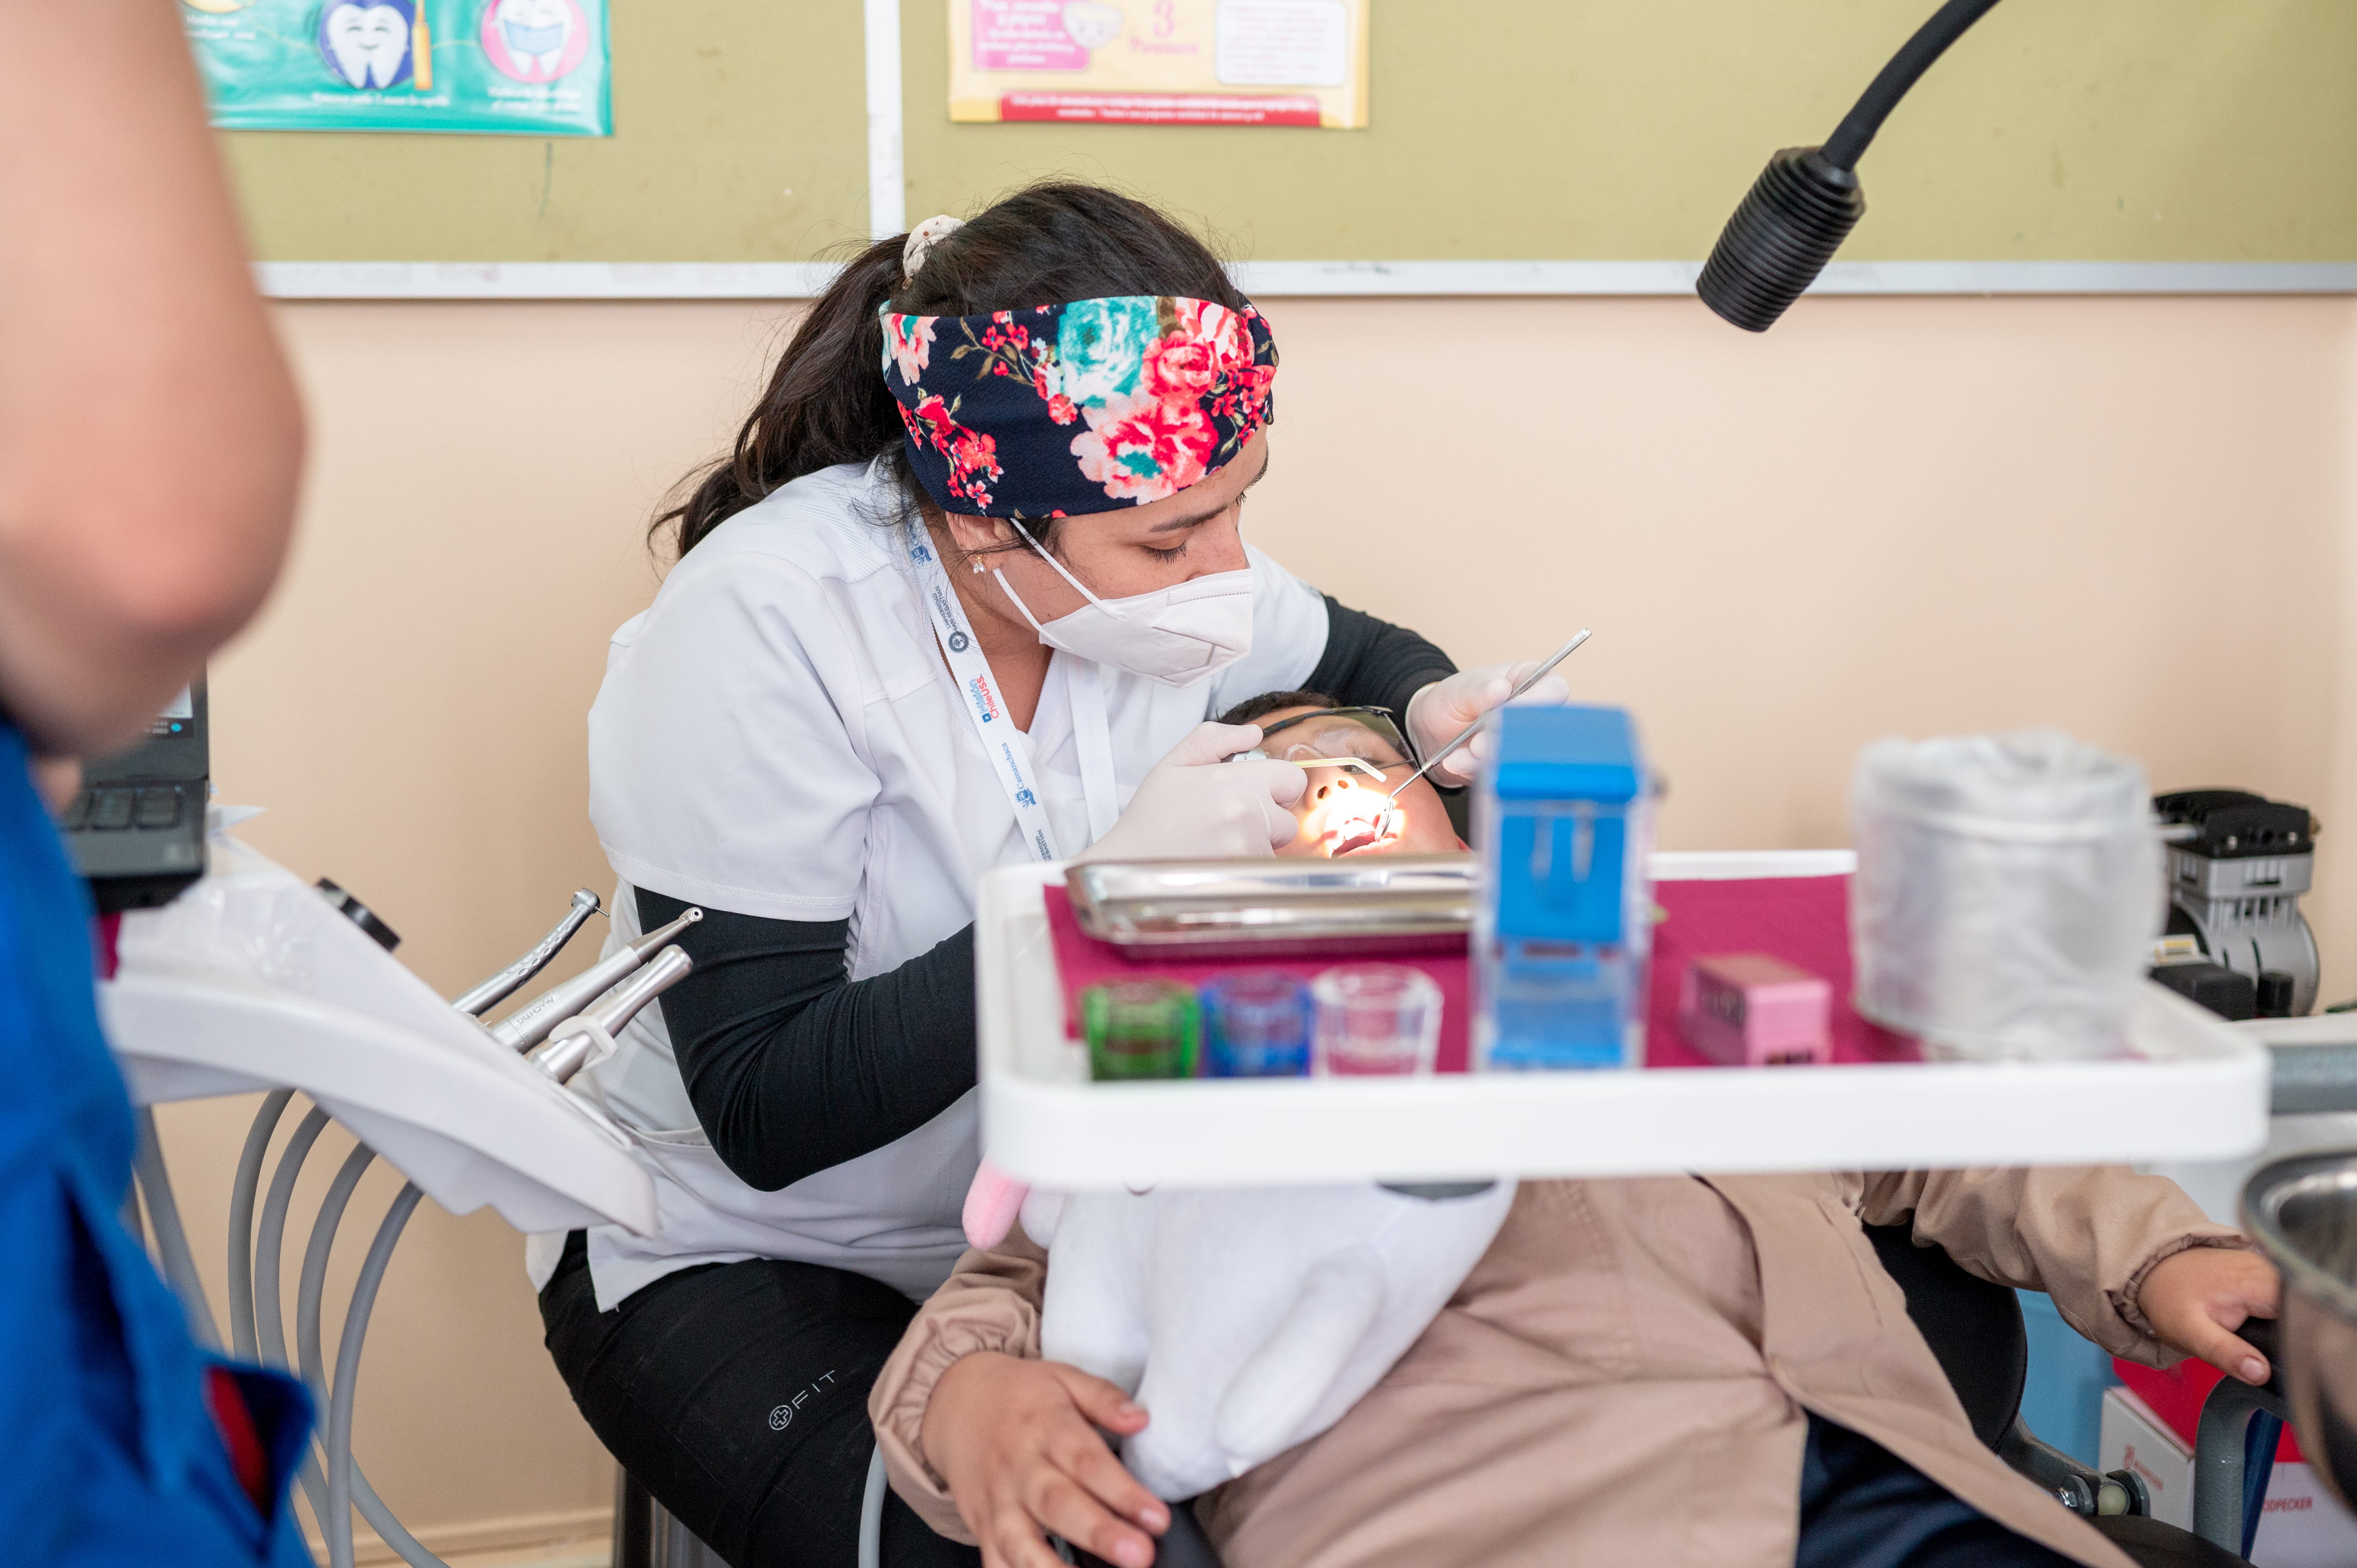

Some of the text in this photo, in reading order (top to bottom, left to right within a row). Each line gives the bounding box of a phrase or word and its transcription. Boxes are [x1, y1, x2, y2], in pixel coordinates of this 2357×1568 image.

[933, 593, 951, 629] UNIVERSIDAD
[935, 585, 953, 618] SEBASTIAN
[969, 679, 988, 714] Misión
[1002, 742, 1024, 789] Camanchaca
[1036, 836, 1048, 862] VERSIDAD
[792, 1370, 835, 1409] FIT
